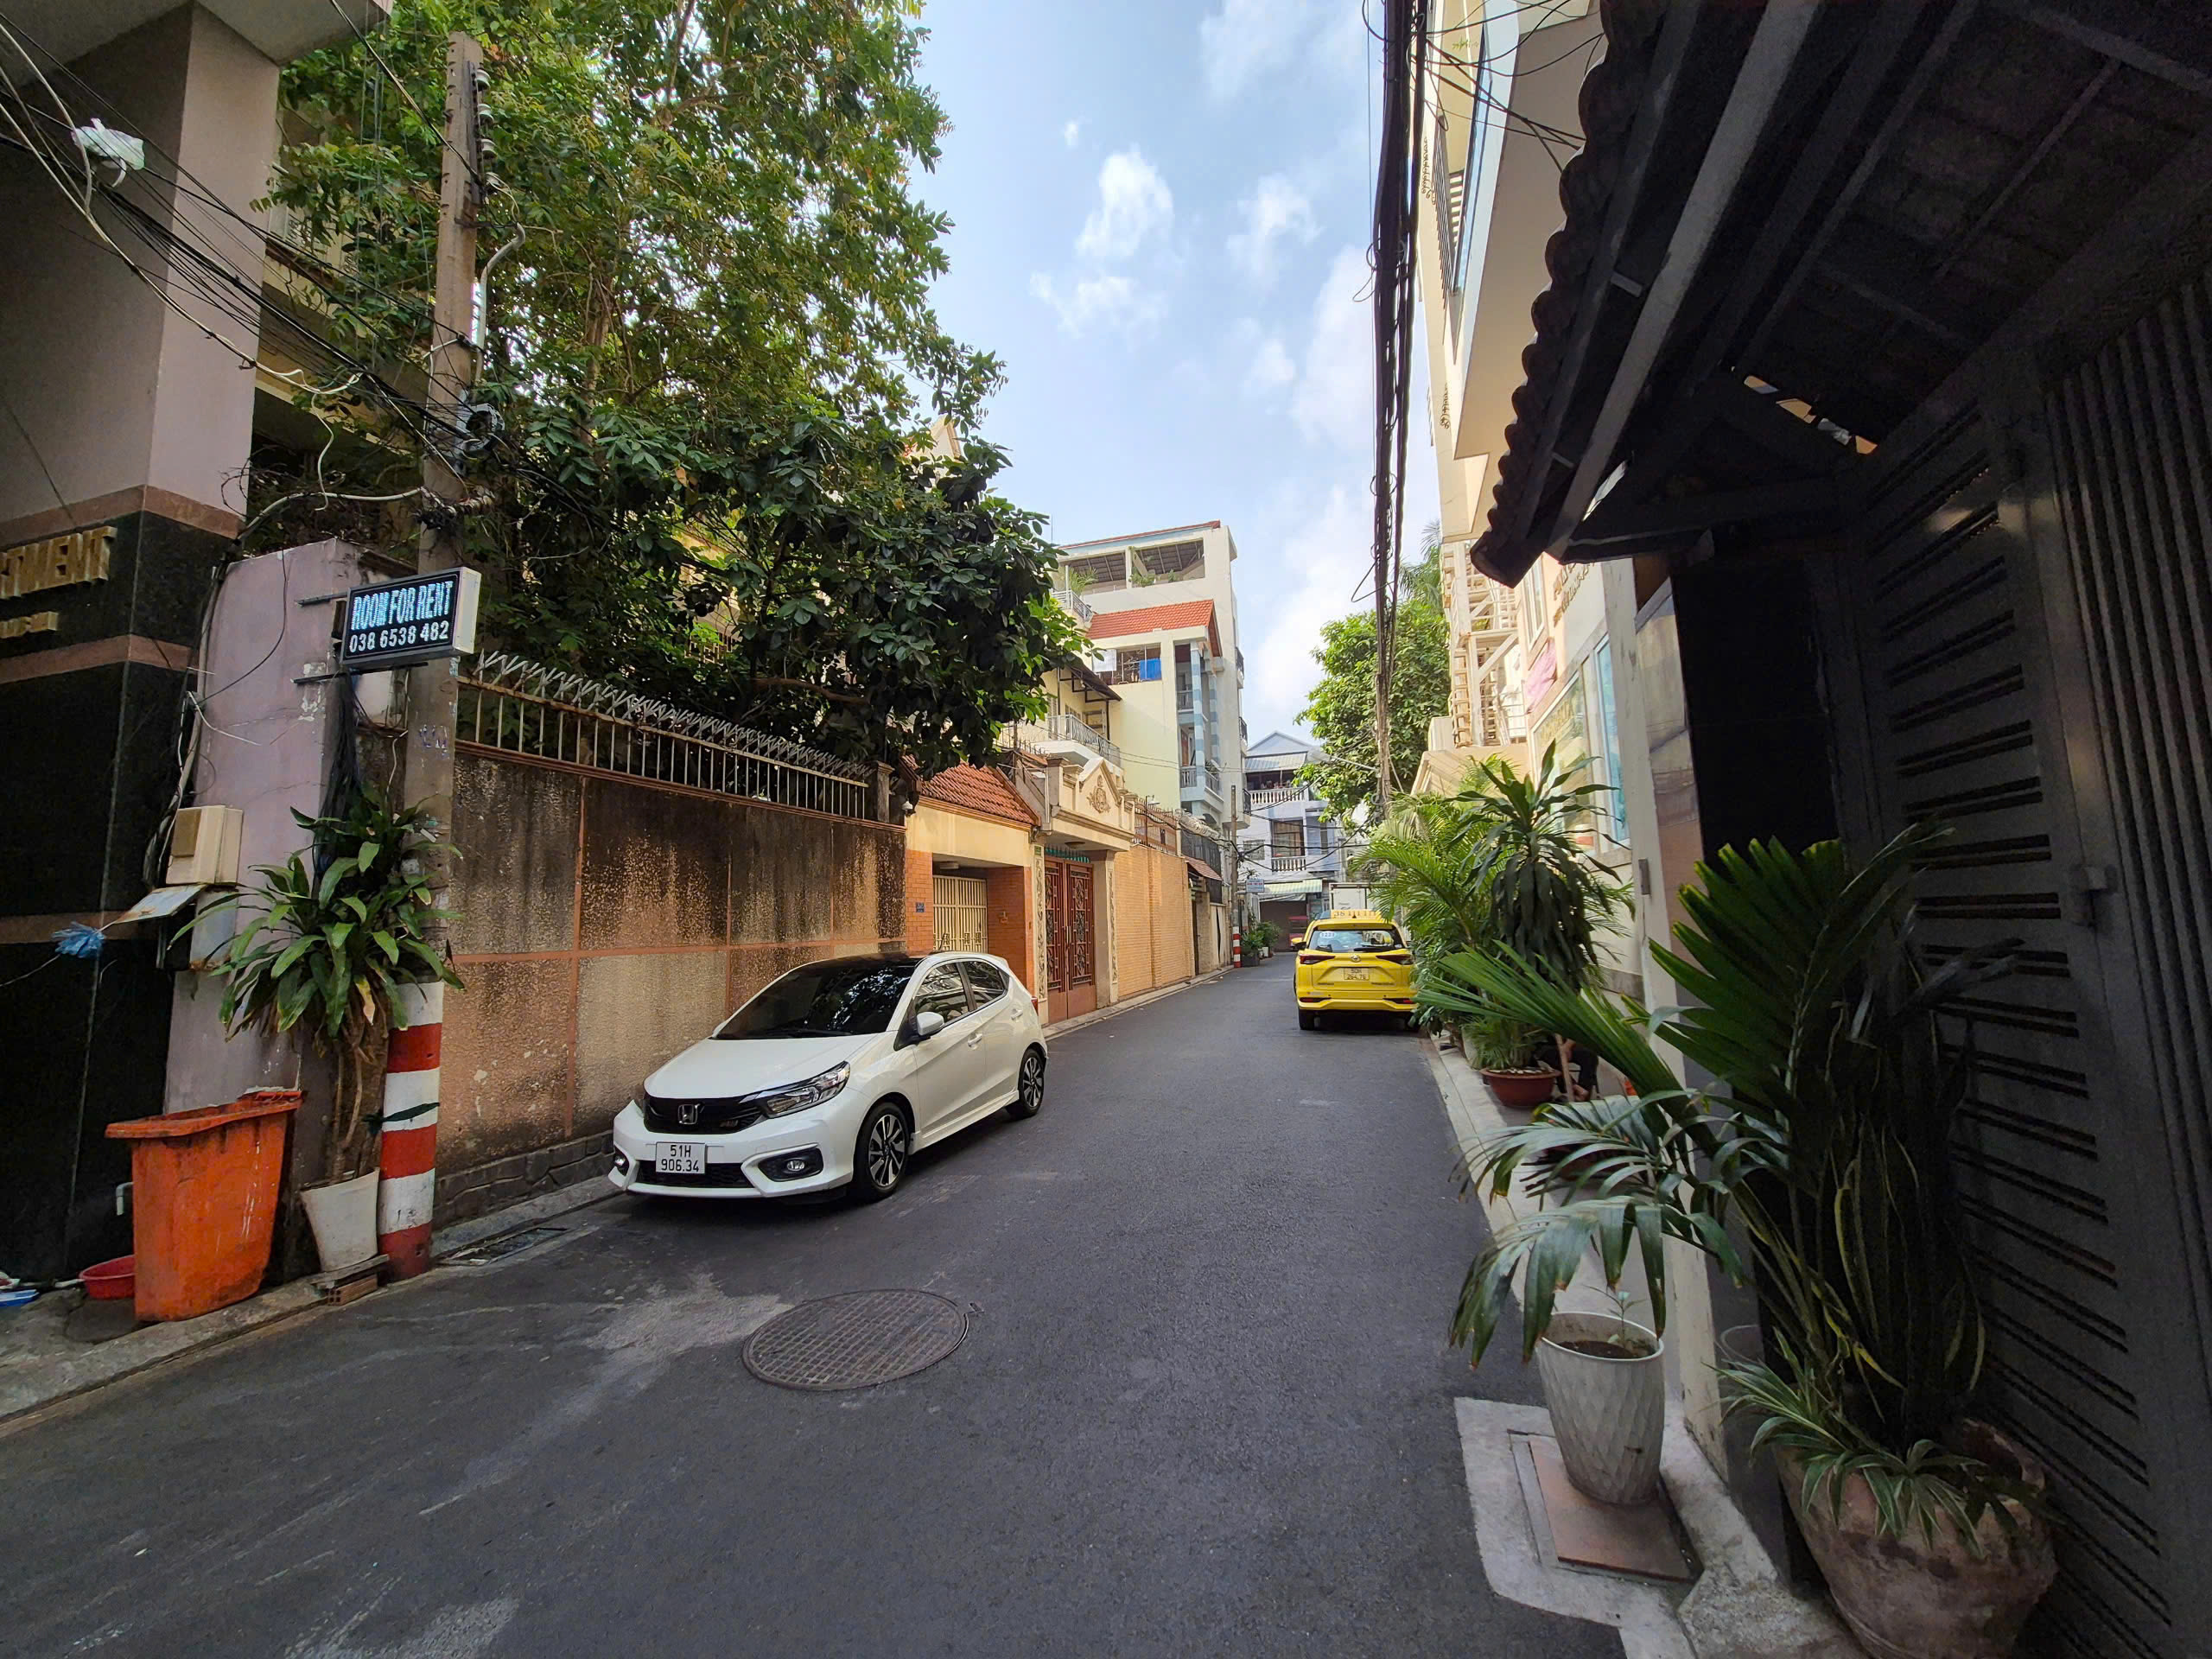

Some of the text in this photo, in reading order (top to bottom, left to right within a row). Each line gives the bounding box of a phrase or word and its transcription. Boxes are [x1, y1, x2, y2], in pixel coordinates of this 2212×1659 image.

[351, 581, 454, 630] ROOM FOR RENT
[349, 620, 449, 652] 038 6538 482
[670, 1144, 691, 1158] 51H
[661, 1159, 699, 1172] 906.34
